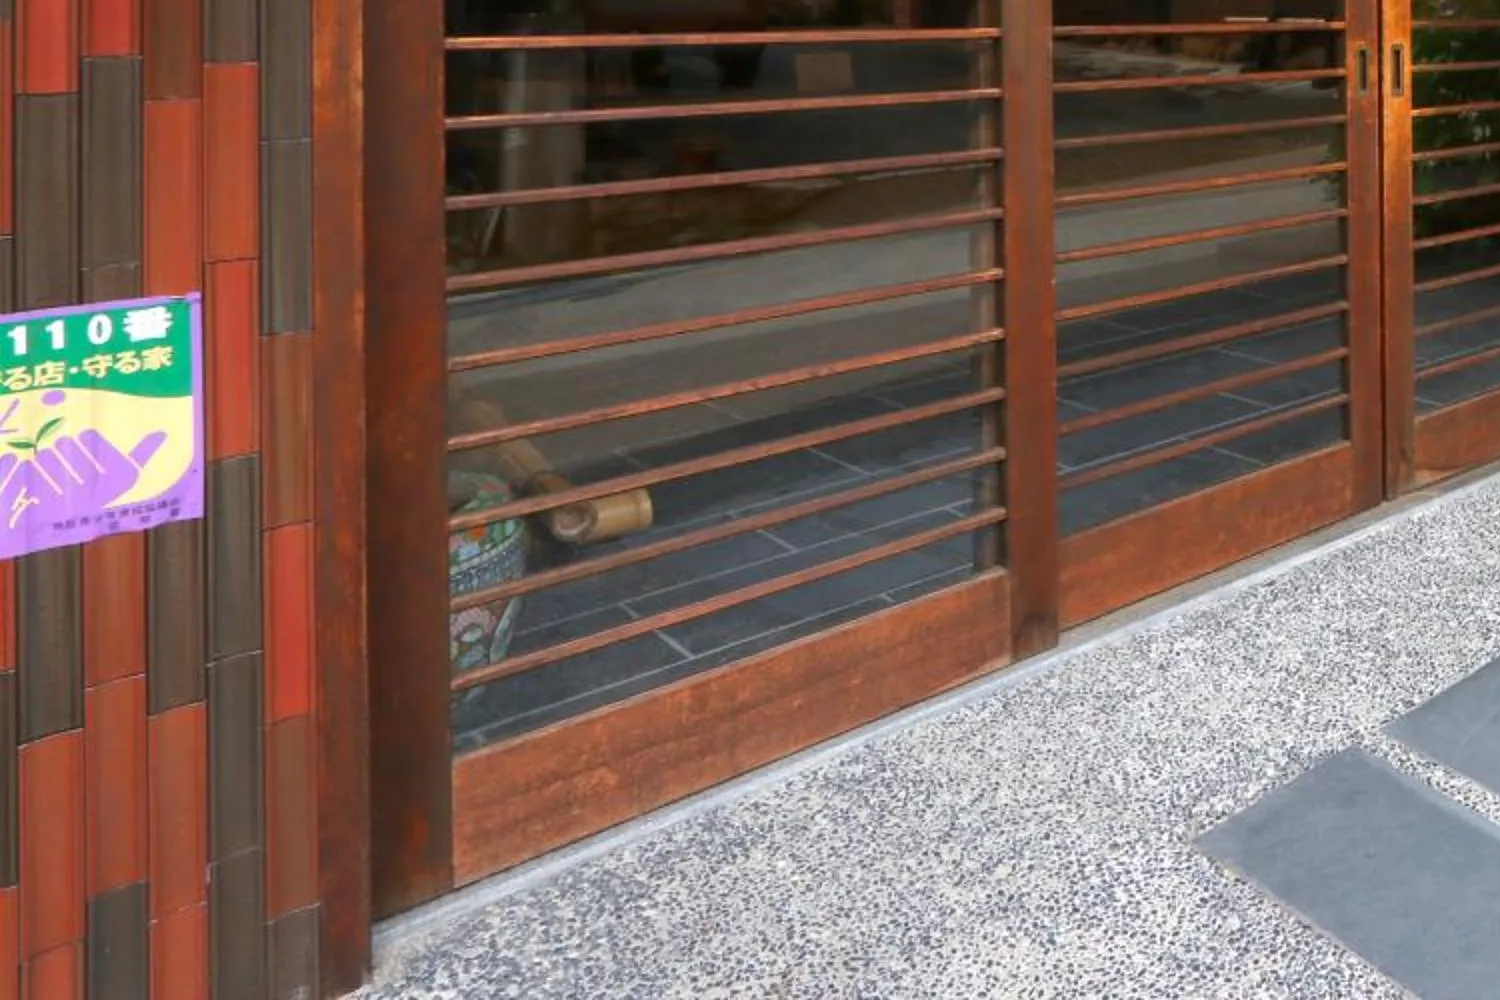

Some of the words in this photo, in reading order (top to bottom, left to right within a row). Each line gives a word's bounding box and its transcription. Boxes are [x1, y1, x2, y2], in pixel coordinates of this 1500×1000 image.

[0, 346, 173, 391] る店・守る家
